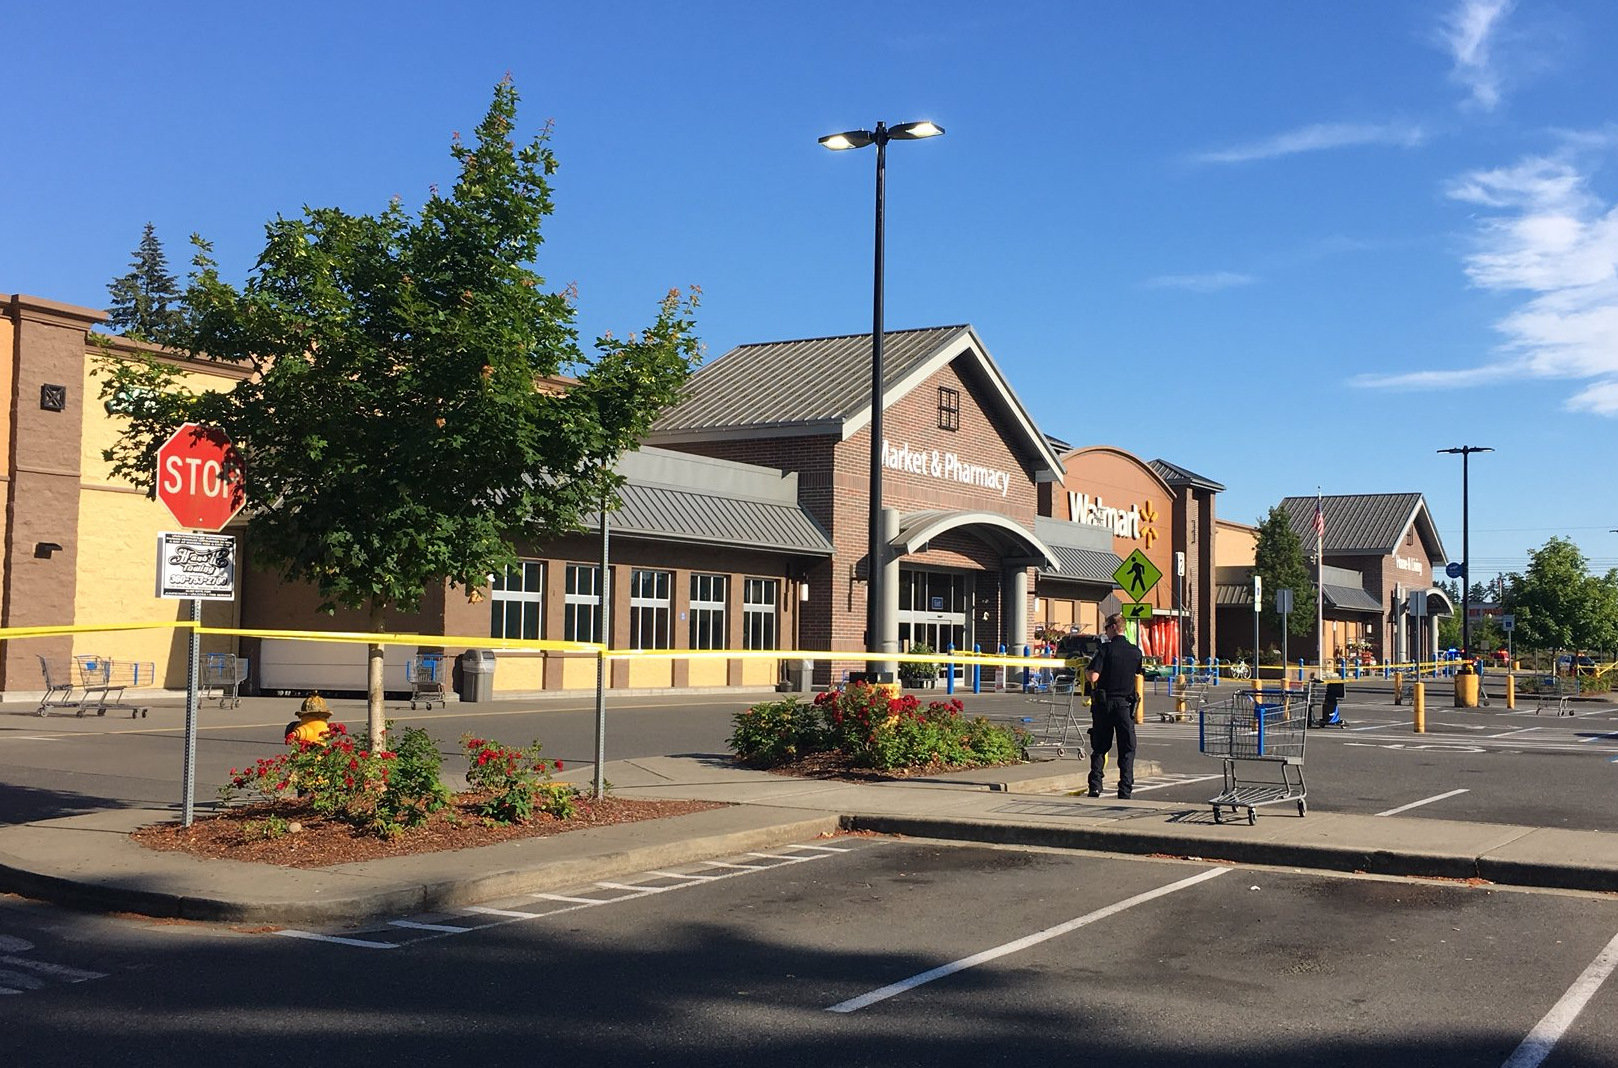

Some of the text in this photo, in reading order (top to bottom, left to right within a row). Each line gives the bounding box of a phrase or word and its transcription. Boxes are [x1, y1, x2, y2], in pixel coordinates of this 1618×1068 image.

[930, 450, 942, 478] &
[945, 452, 1010, 497] Pharmacy
[1067, 490, 1141, 540] Walmart
[182, 563, 216, 576] Towing
